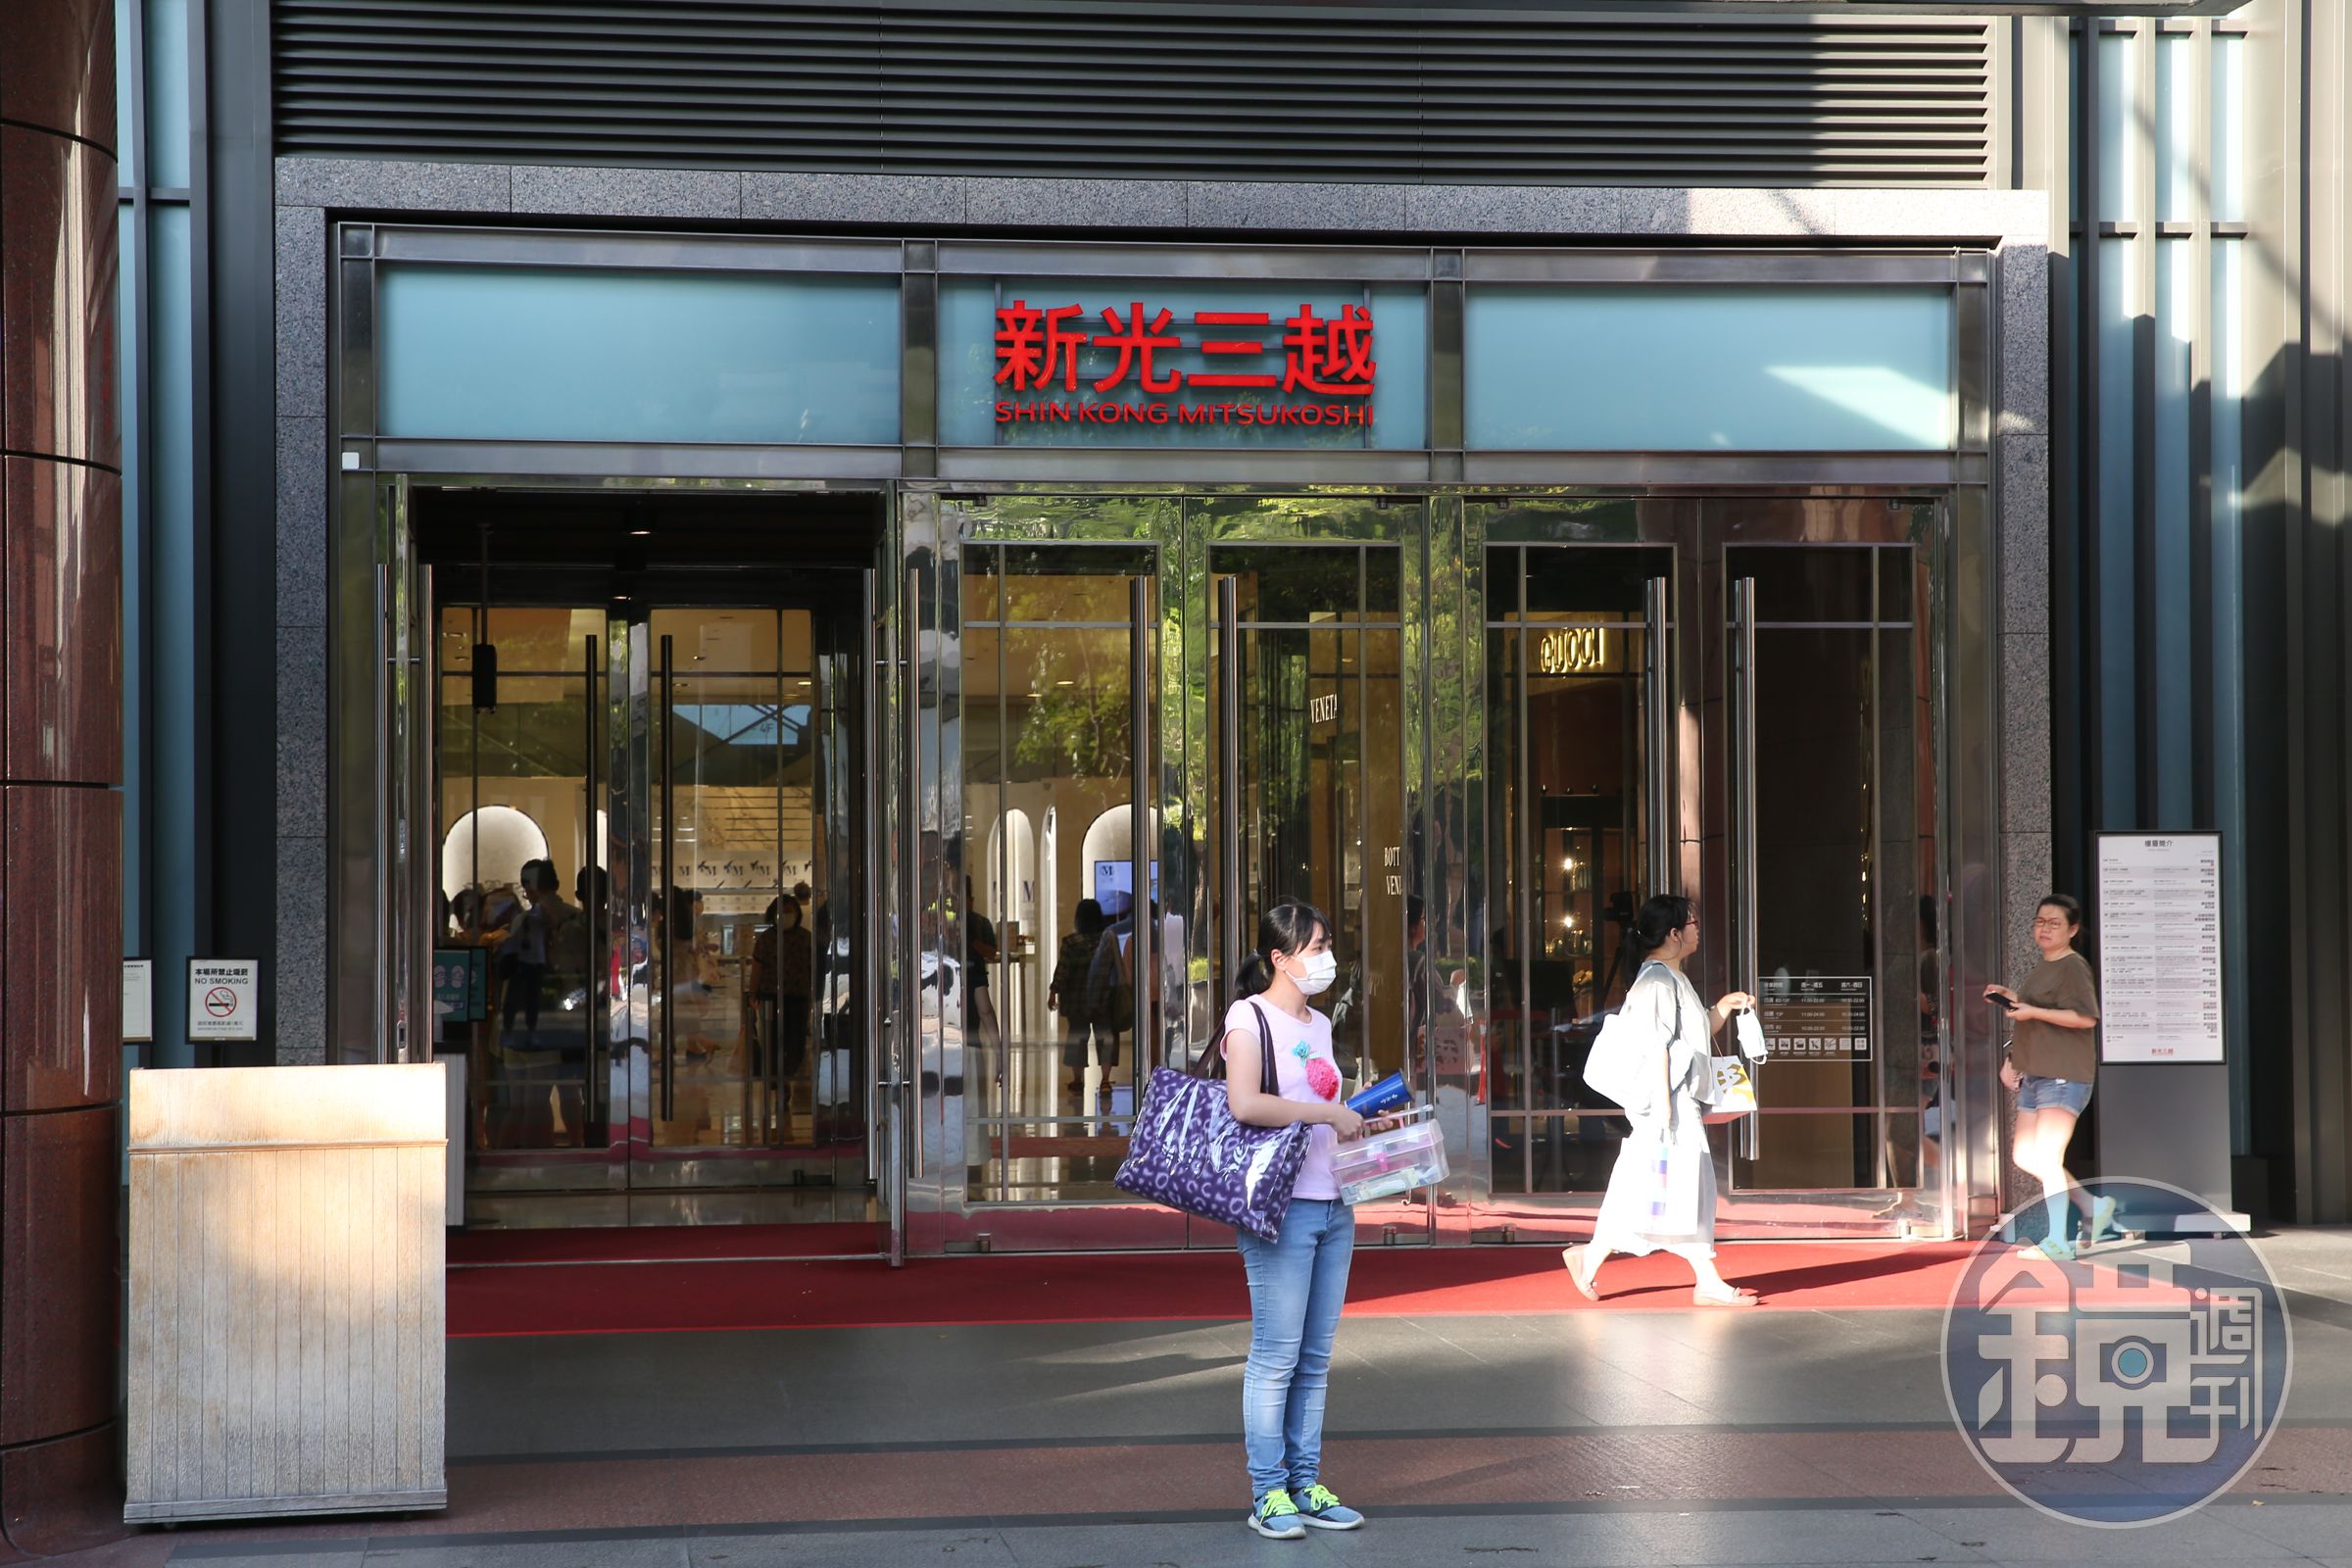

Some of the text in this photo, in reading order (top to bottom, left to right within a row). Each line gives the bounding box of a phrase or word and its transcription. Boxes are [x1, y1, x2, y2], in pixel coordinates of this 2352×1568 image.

[993, 300, 1377, 396] 新光三越
[994, 401, 1374, 425] SHIN KONG MITSUKOSHI
[1540, 627, 1604, 673] GUCCI
